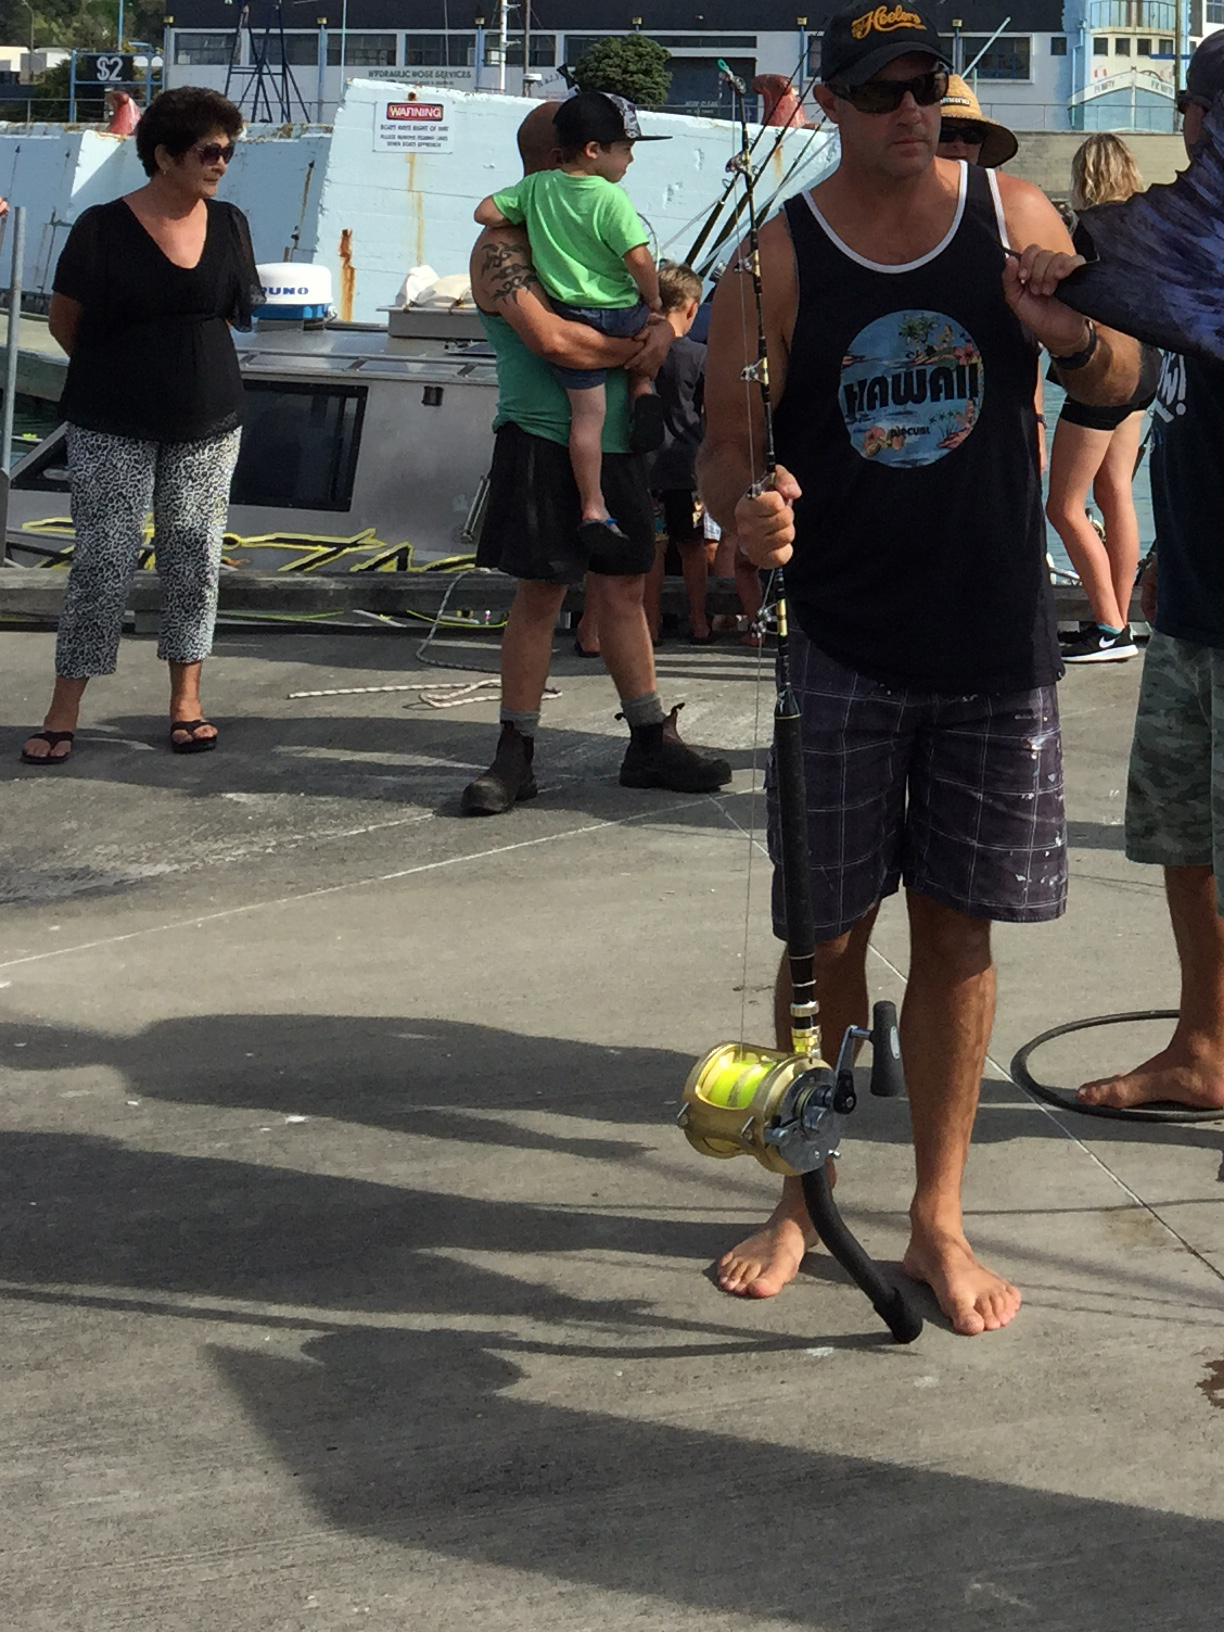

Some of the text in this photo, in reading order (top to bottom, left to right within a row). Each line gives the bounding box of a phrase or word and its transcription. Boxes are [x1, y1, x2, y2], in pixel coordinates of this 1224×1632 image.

[96, 56, 123, 81] $2
[389, 104, 442, 118] WARNING
[843, 364, 979, 419] HAWAII
